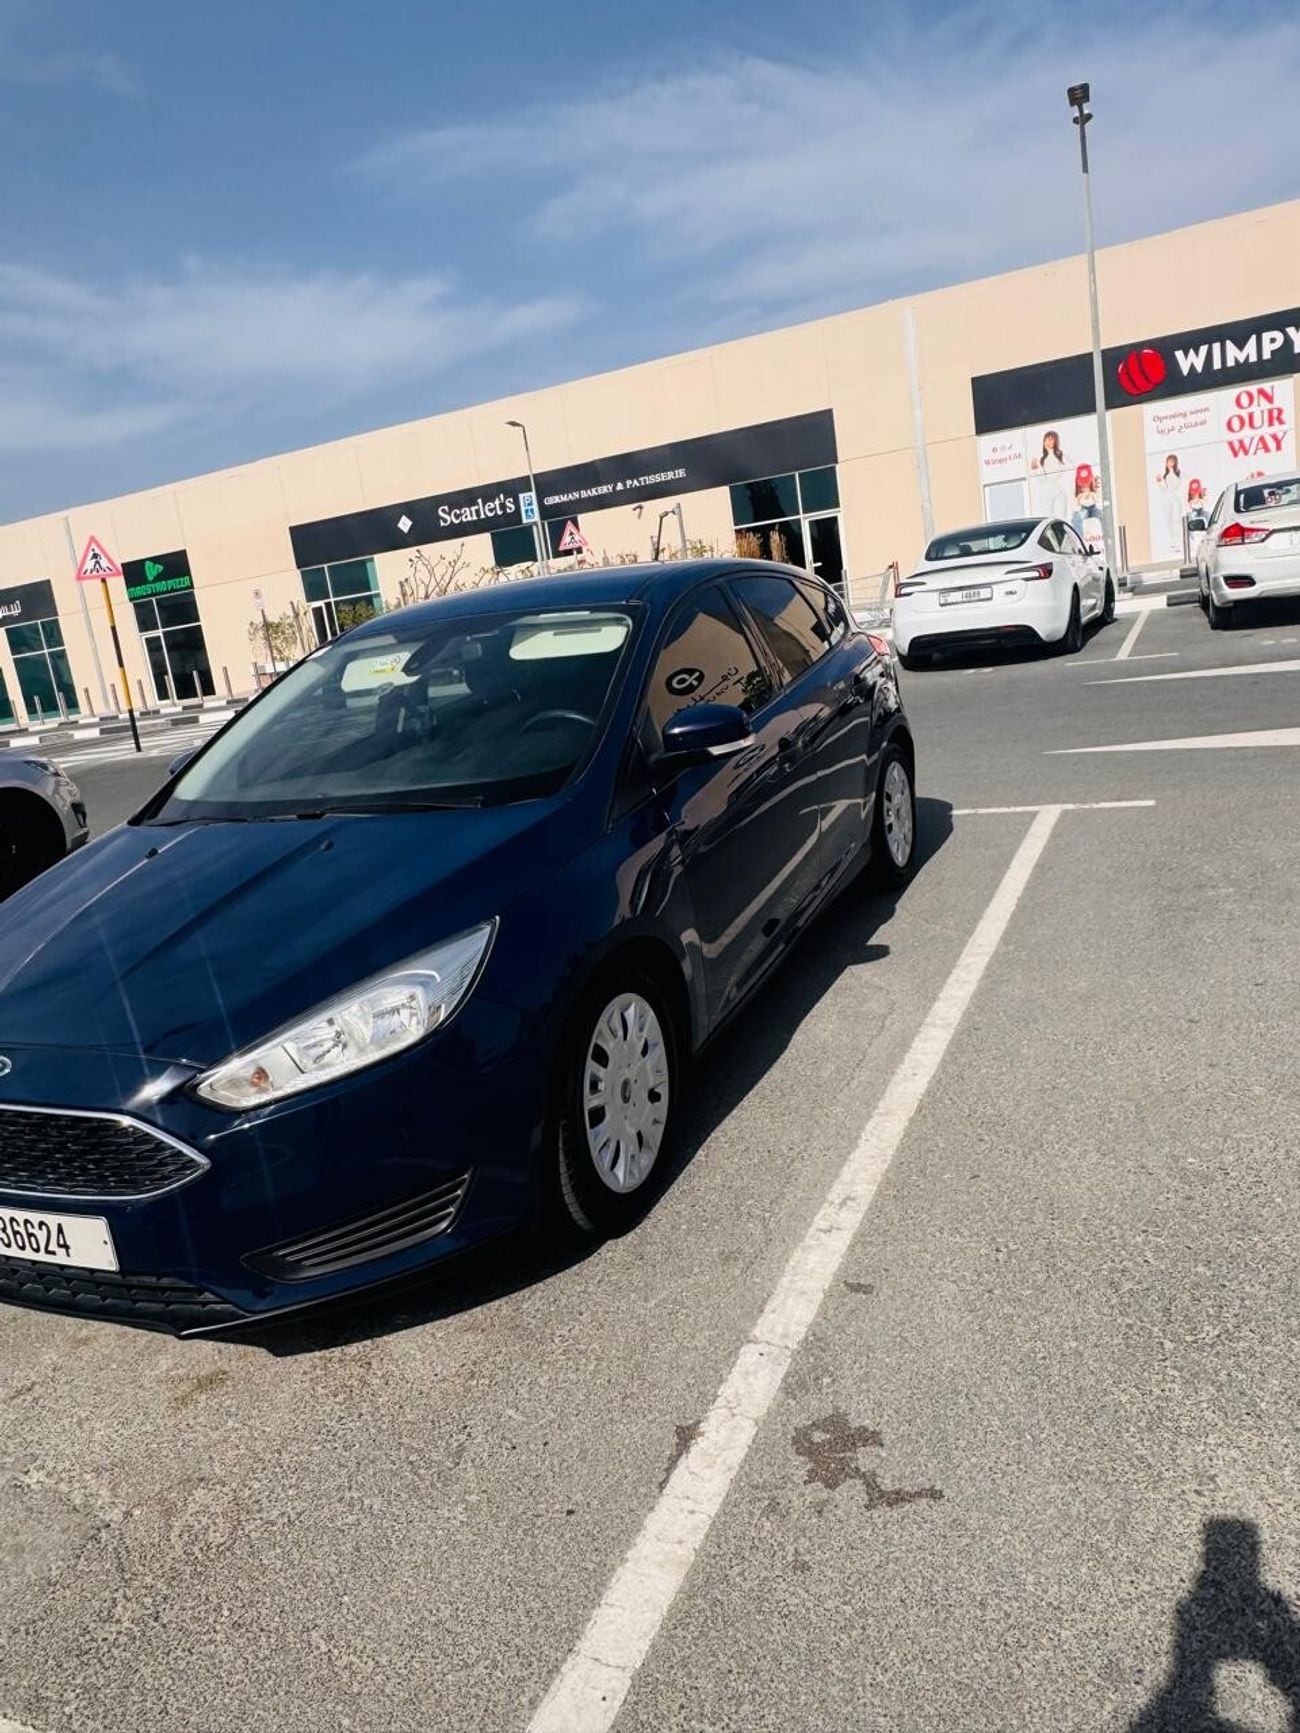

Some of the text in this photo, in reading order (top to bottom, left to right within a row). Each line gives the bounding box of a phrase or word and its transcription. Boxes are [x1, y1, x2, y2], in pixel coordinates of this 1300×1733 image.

[1235, 384, 1275, 410] ON
[1152, 411, 1188, 424] Opening
[1226, 407, 1286, 433] OUR
[1227, 431, 1288, 459] WAY
[543, 468, 687, 505] GERMAN BAKERY & PATISSERIE
[438, 493, 516, 527] Scarlet's
